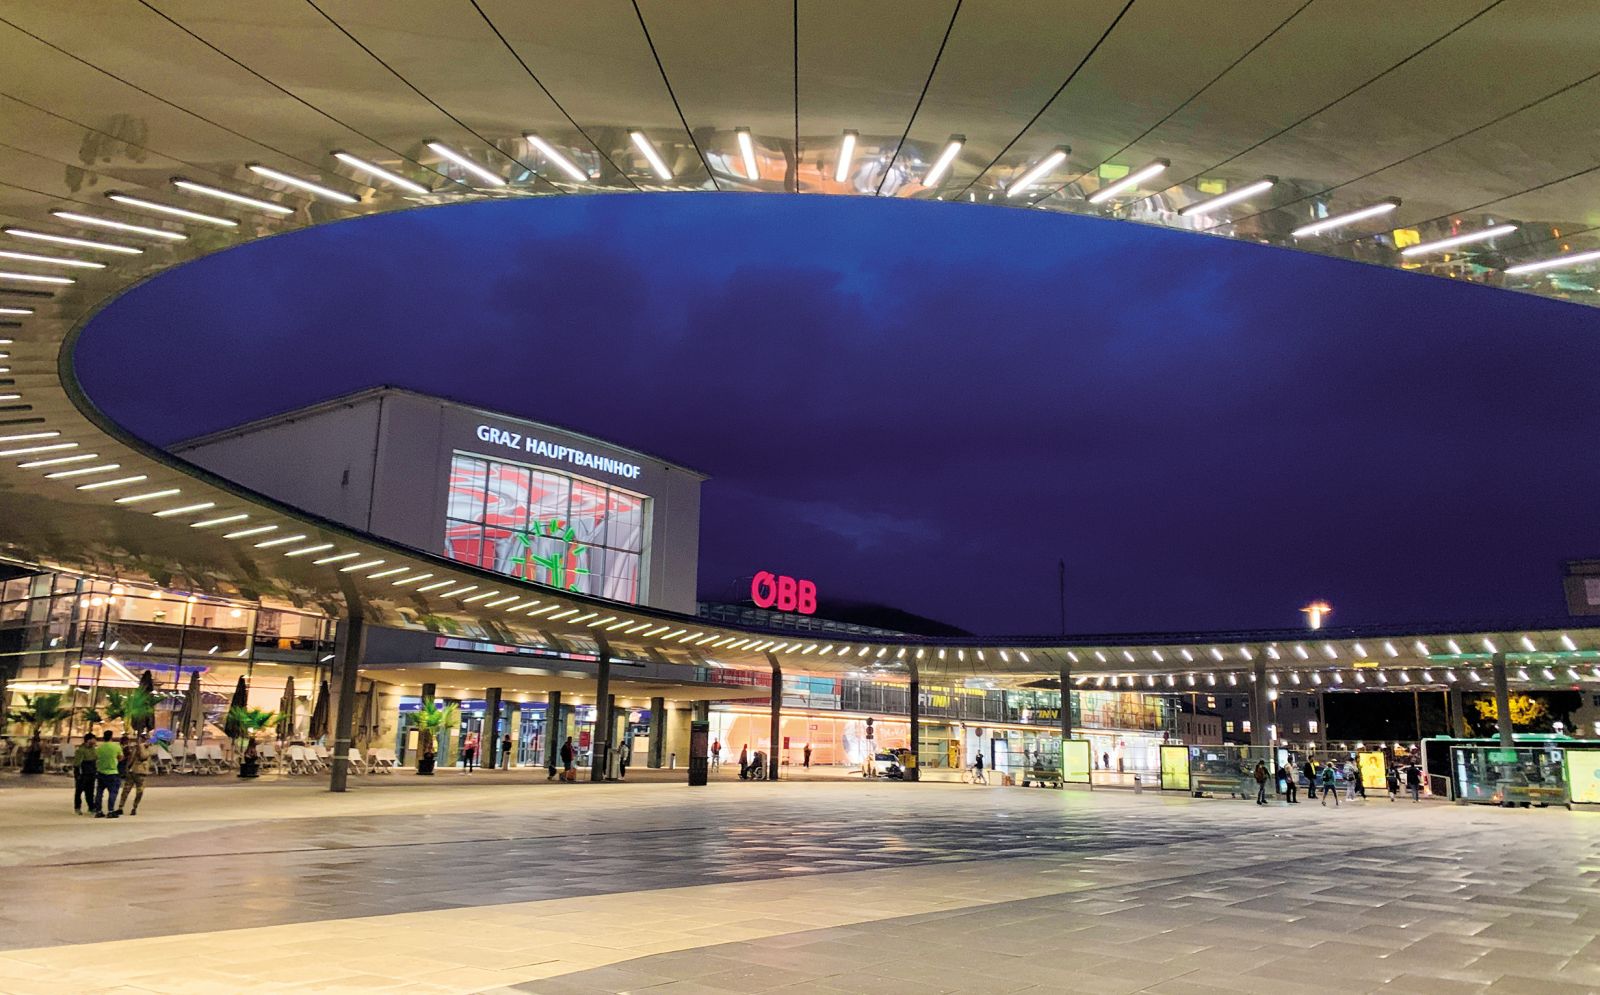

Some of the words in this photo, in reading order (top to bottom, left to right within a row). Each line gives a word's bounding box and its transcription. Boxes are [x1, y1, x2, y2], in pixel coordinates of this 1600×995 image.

[476, 425, 521, 450] GRAZ
[525, 437, 641, 479] HAUPTBAHNHOF
[751, 570, 817, 615] ÖBB
